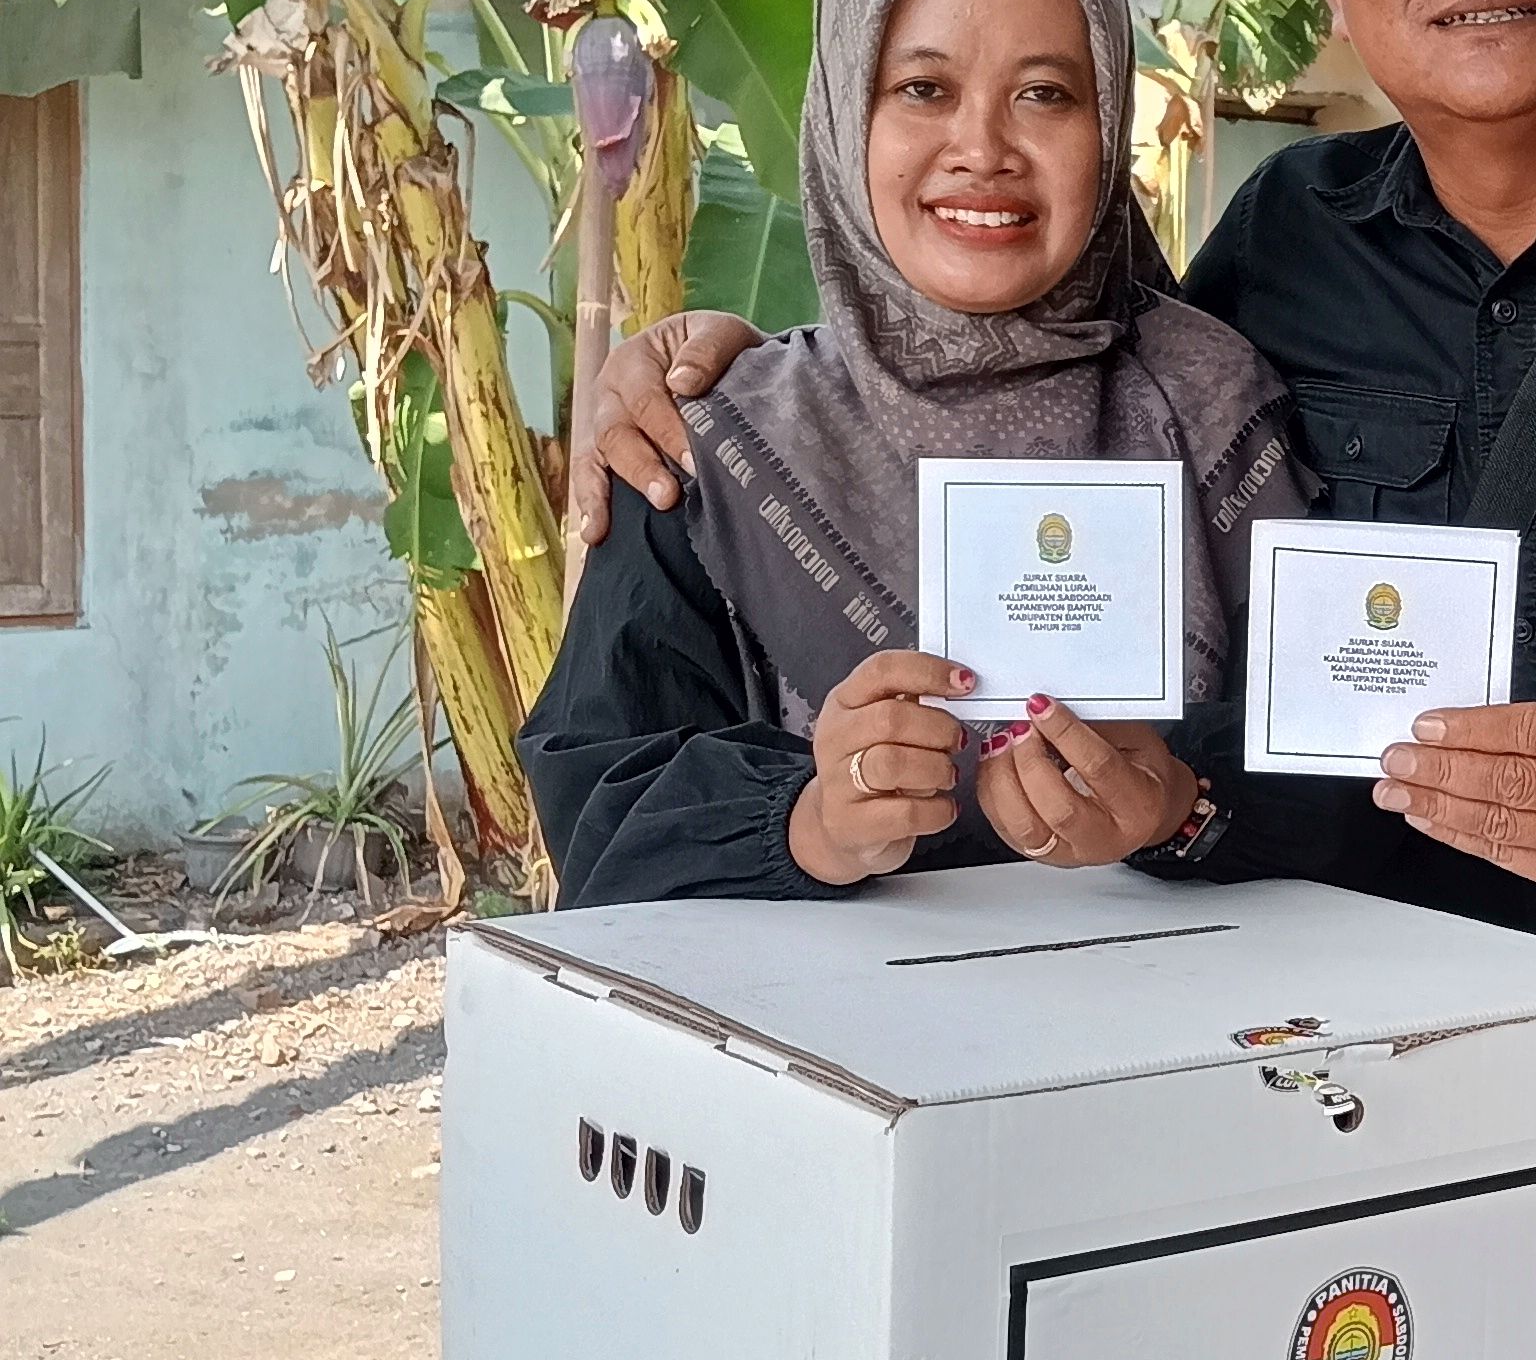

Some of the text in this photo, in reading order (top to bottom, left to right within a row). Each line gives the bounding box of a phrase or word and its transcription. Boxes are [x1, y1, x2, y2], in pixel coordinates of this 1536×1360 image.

[1065, 584, 1097, 592] LURAH
[998, 594, 1056, 602] KALURAHAN
[1067, 603, 1104, 612] BANTUL
[1008, 613, 1102, 622] KABUPATEN BANTUL
[1028, 623, 1060, 632] TAHUN
[1381, 640, 1414, 649] SUARA
[1339, 646, 1424, 658] PEMILIHAN LURAH
[1323, 655, 1381, 665] KALURAHAN
[1330, 664, 1430, 678] KAPANEWON BANTUL
[1332, 674, 1427, 687] KABUPATEN BANTUL
[1353, 684, 1384, 693] TAHUN
[1314, 1273, 1389, 1310] PANITIA
